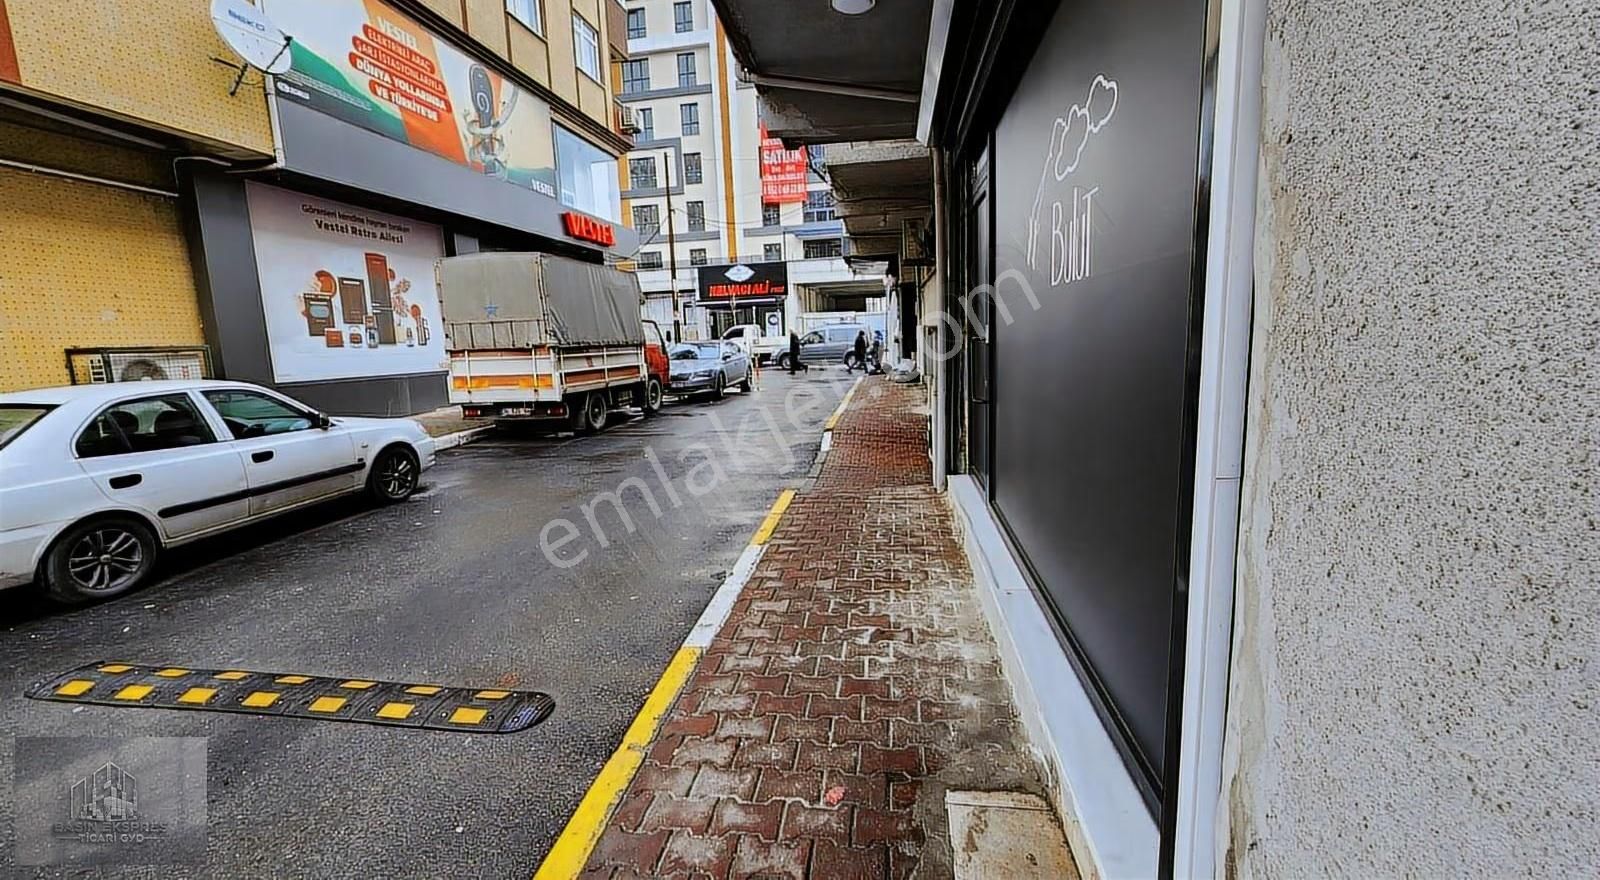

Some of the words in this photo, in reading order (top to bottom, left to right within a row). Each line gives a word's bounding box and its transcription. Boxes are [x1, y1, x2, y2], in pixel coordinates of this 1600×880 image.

[377, 16, 417, 48] VESTEL
[355, 58, 392, 84] DÜNYA
[375, 83, 390, 100] VE
[531, 179, 556, 198] VESTEL
[314, 218, 349, 234] Vestel
[562, 211, 616, 247] VESTEL
